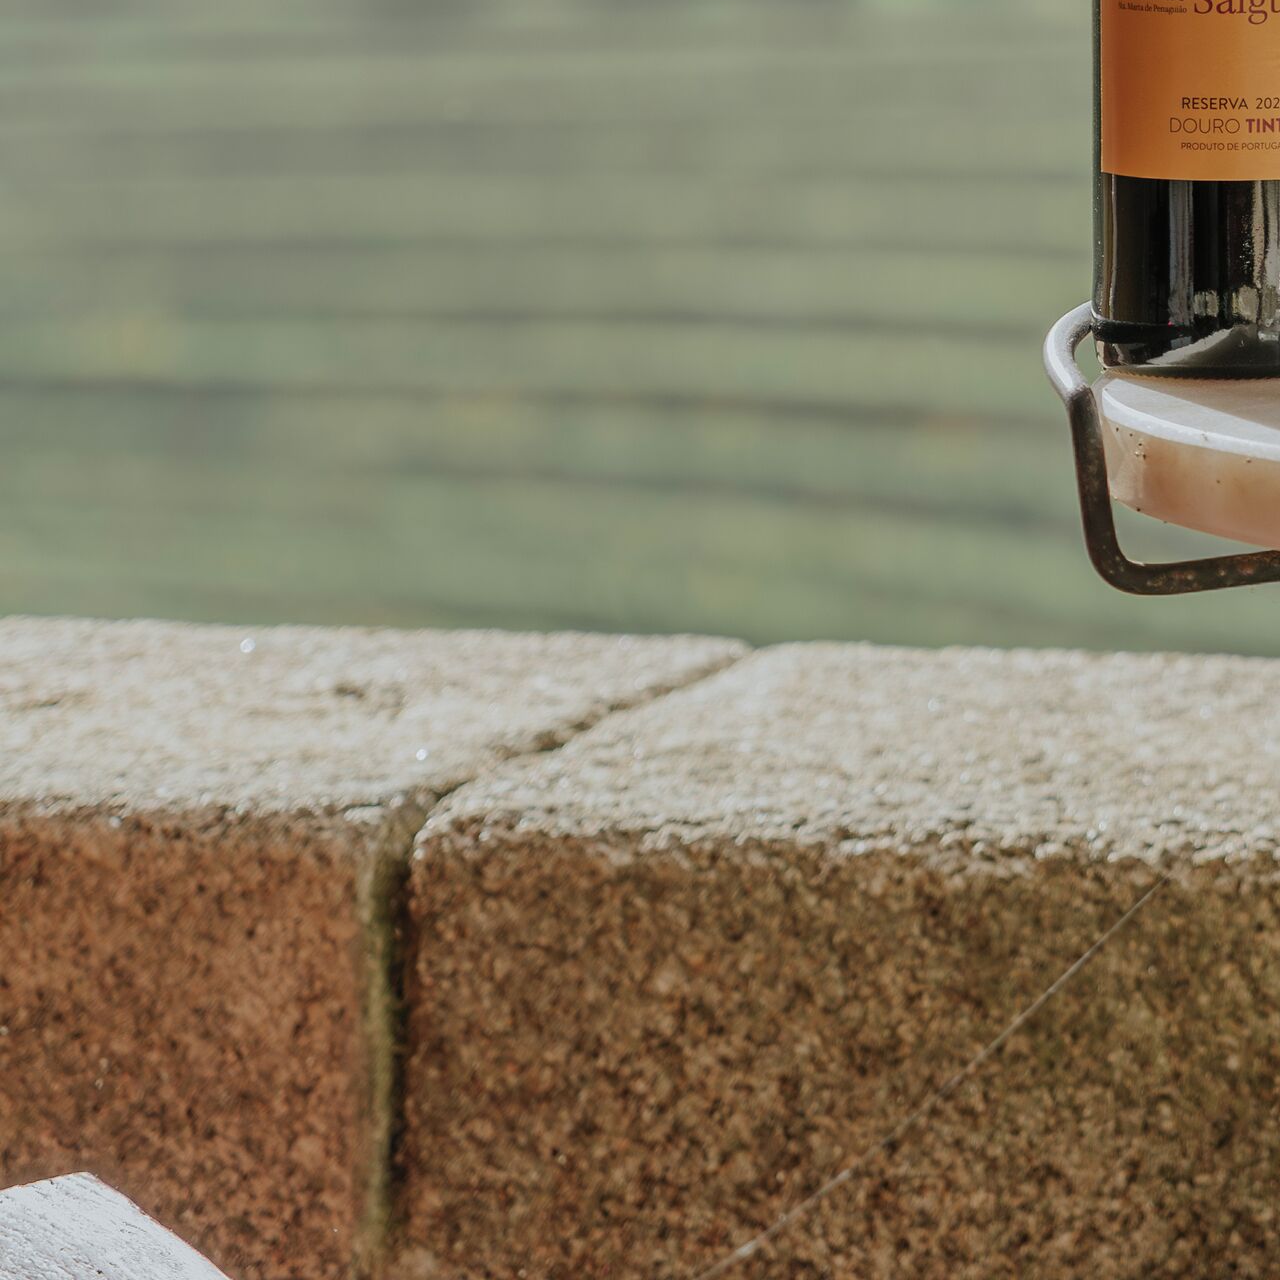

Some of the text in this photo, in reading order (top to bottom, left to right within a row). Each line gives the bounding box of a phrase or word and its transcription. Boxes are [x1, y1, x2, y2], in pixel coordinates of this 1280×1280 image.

[1181, 97, 1249, 110] RESERVA
[1169, 117, 1241, 134] DOURO
[1180, 142, 1225, 151] PRODUTO
[1227, 142, 1239, 151] DE
